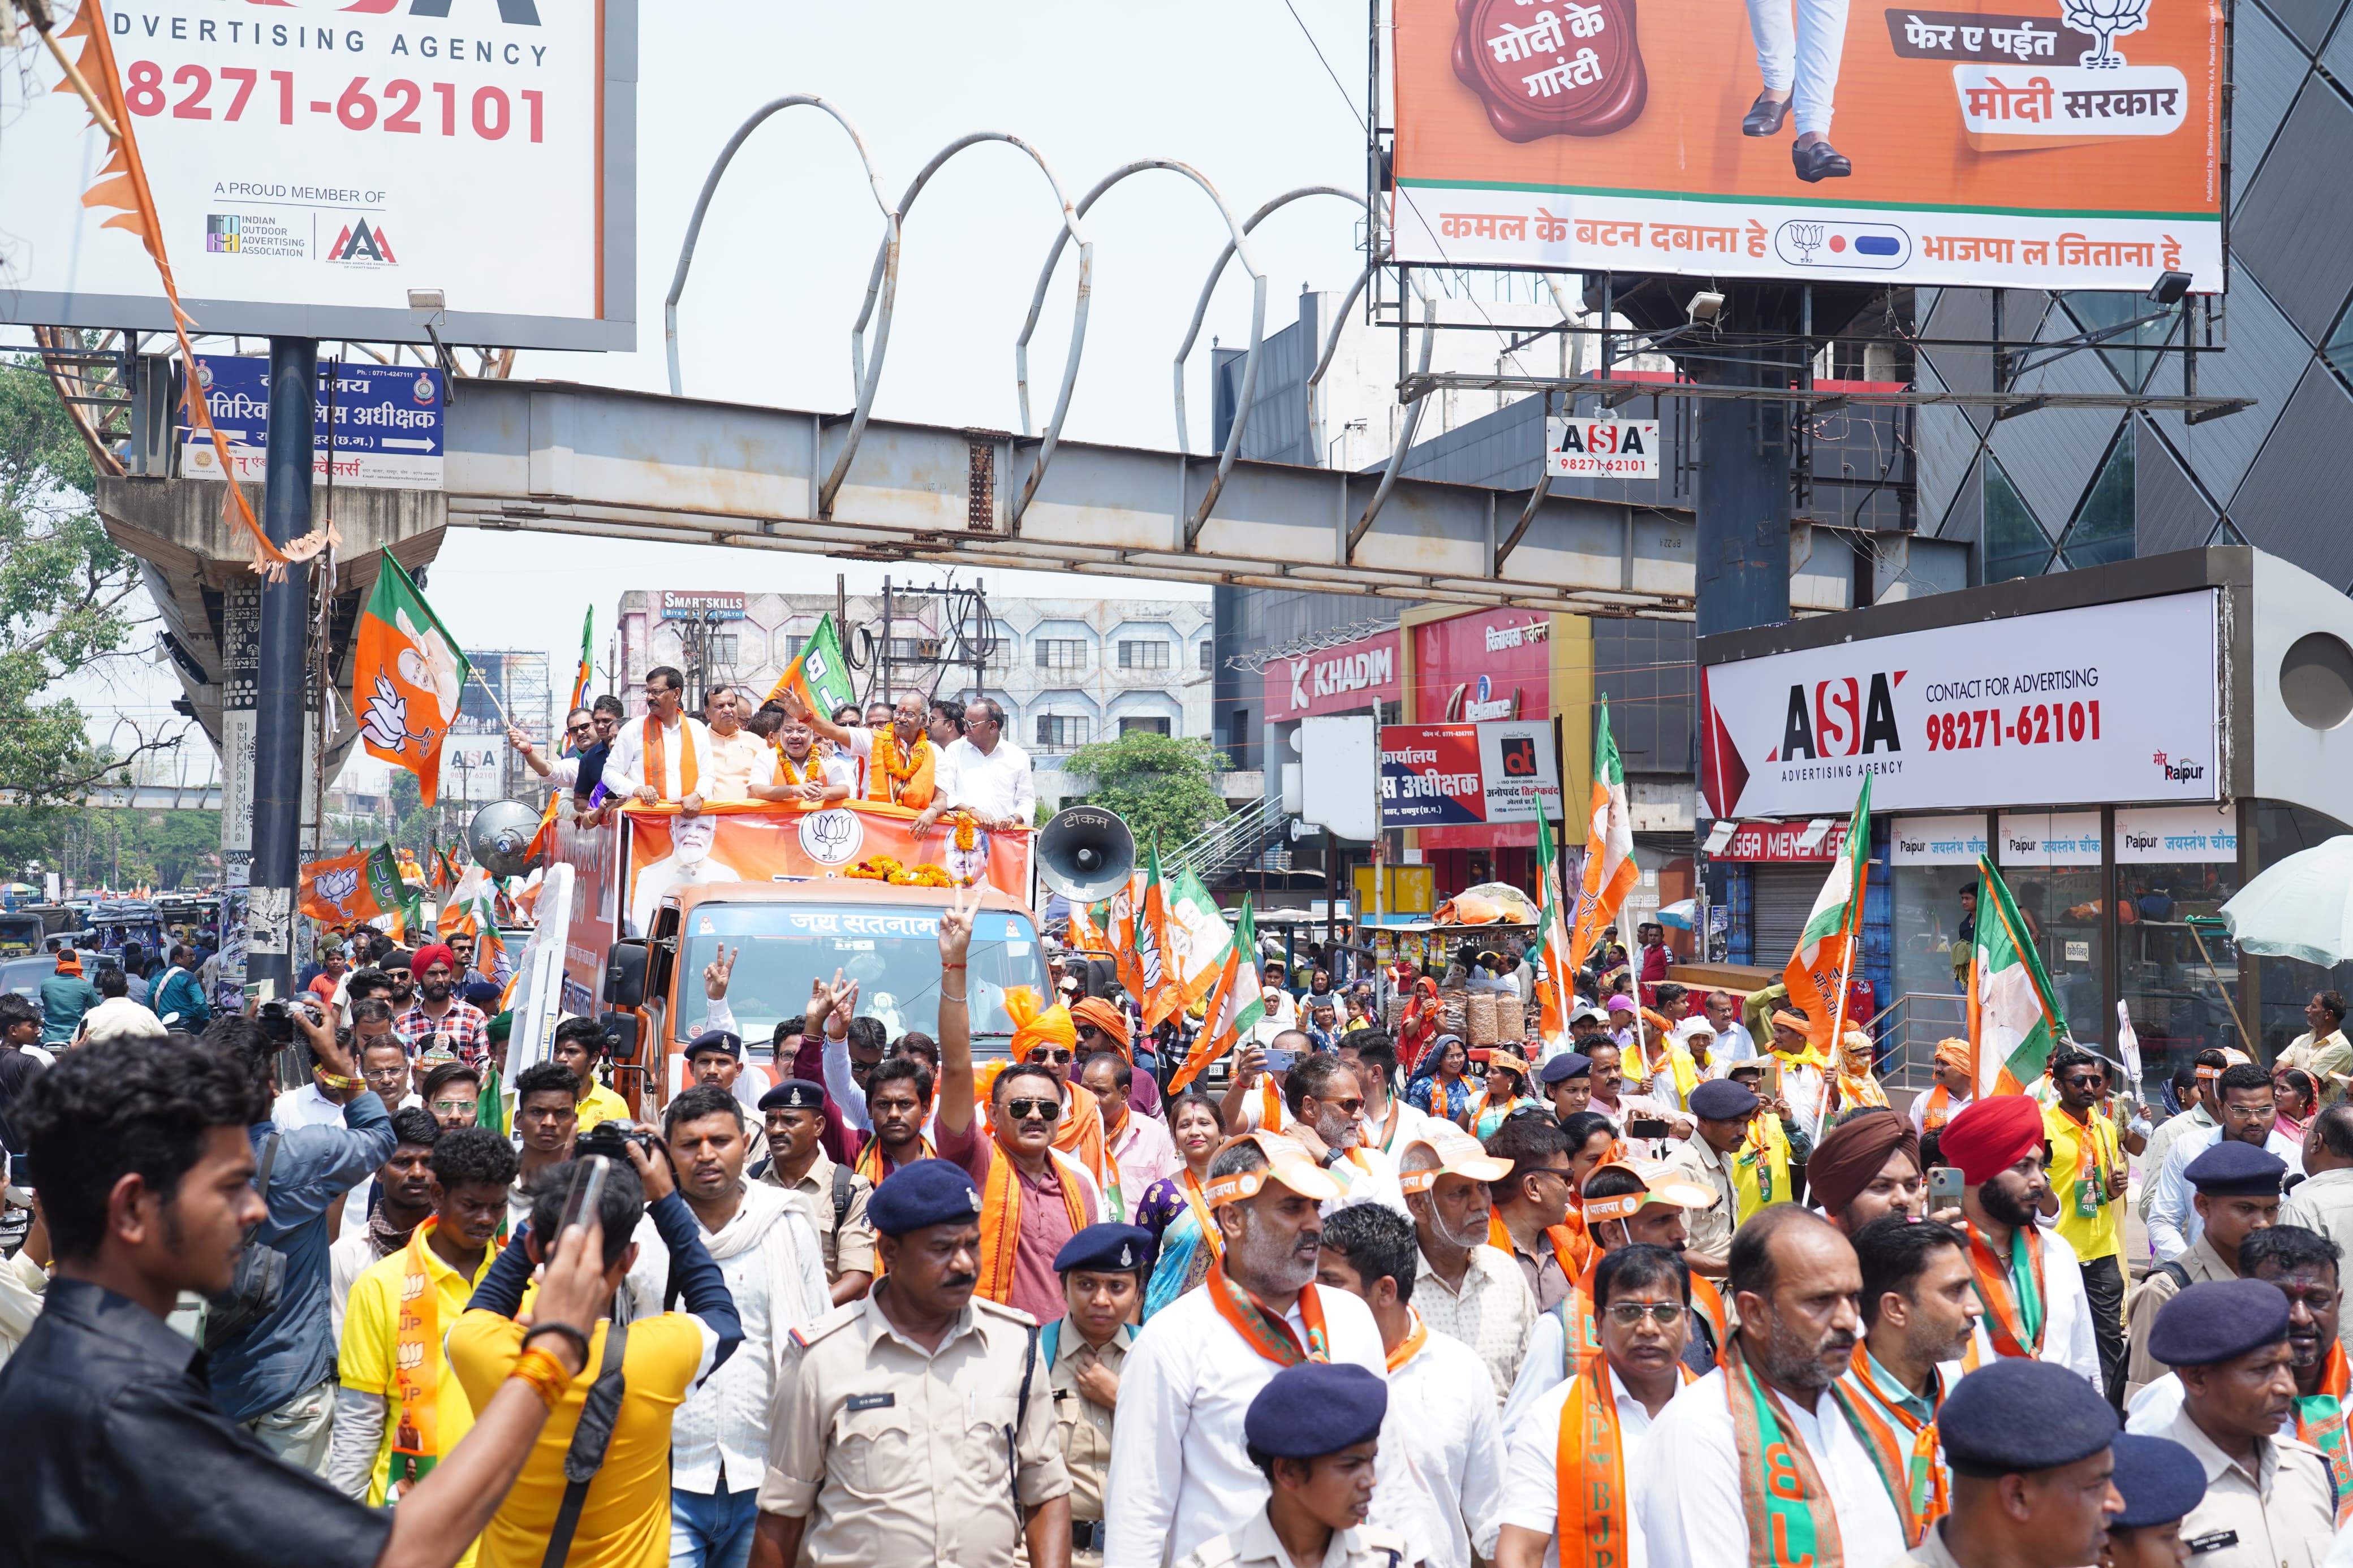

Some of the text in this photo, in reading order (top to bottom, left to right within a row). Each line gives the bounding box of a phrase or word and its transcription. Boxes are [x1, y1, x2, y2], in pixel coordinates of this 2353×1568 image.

[1487, 2, 1605, 63] मोदी के
[1904, 15, 2057, 61] फेर ए पईत
[391, 33, 547, 67] AGENCY
[1522, 47, 1604, 98] गारंटी
[1966, 76, 2179, 123] मोदी सरकार
[214, 182, 386, 203] A PROUD MEMBER OF
[242, 216, 275, 225] INDIAN
[242, 227, 287, 236] OUTDOOR
[242, 236, 305, 247] ADVERTISING
[1440, 207, 1768, 258] कमल के बटन दबाना हे
[242, 247, 303, 257] ASSOCIATION
[1922, 232, 2182, 271] भाजपा ल जिताना हे
[353, 400, 436, 429] अधीक्षक
[333, 434, 374, 448] (छ.ग.)
[1561, 425, 1644, 454] ASA
[1561, 459, 1645, 472] 98271-62101
[1486, 619, 1523, 653] रिलायंस
[1314, 647, 1393, 698] KHADIM
[1927, 667, 2098, 702] CONTACT FOR ADVERTISING
[1466, 699, 1511, 723] Reliance
[1782, 672, 1901, 762] ASA
[1927, 700, 2100, 751] 98271-62101
[1381, 746, 1437, 764] कार्यालय
[2153, 749, 2168, 766] मोर
[1402, 768, 1479, 798] अधीक्षक
[1782, 761, 1903, 782] ADVERTISING AGENCY
[1486, 787, 1520, 797] अनोपचंद
[1062, 813, 1110, 829] टीकम
[1930, 835, 1988, 854] जयस्तंभ चौक
[2041, 834, 2101, 854] जयस्तंभ चौक
[2164, 828, 2237, 851] जयस्तंभ चौक
[790, 913, 940, 936] जय सतनाम
[2067, 944, 2087, 960] धकेलिए
[1589, 1201, 1619, 1215] भाजपा
